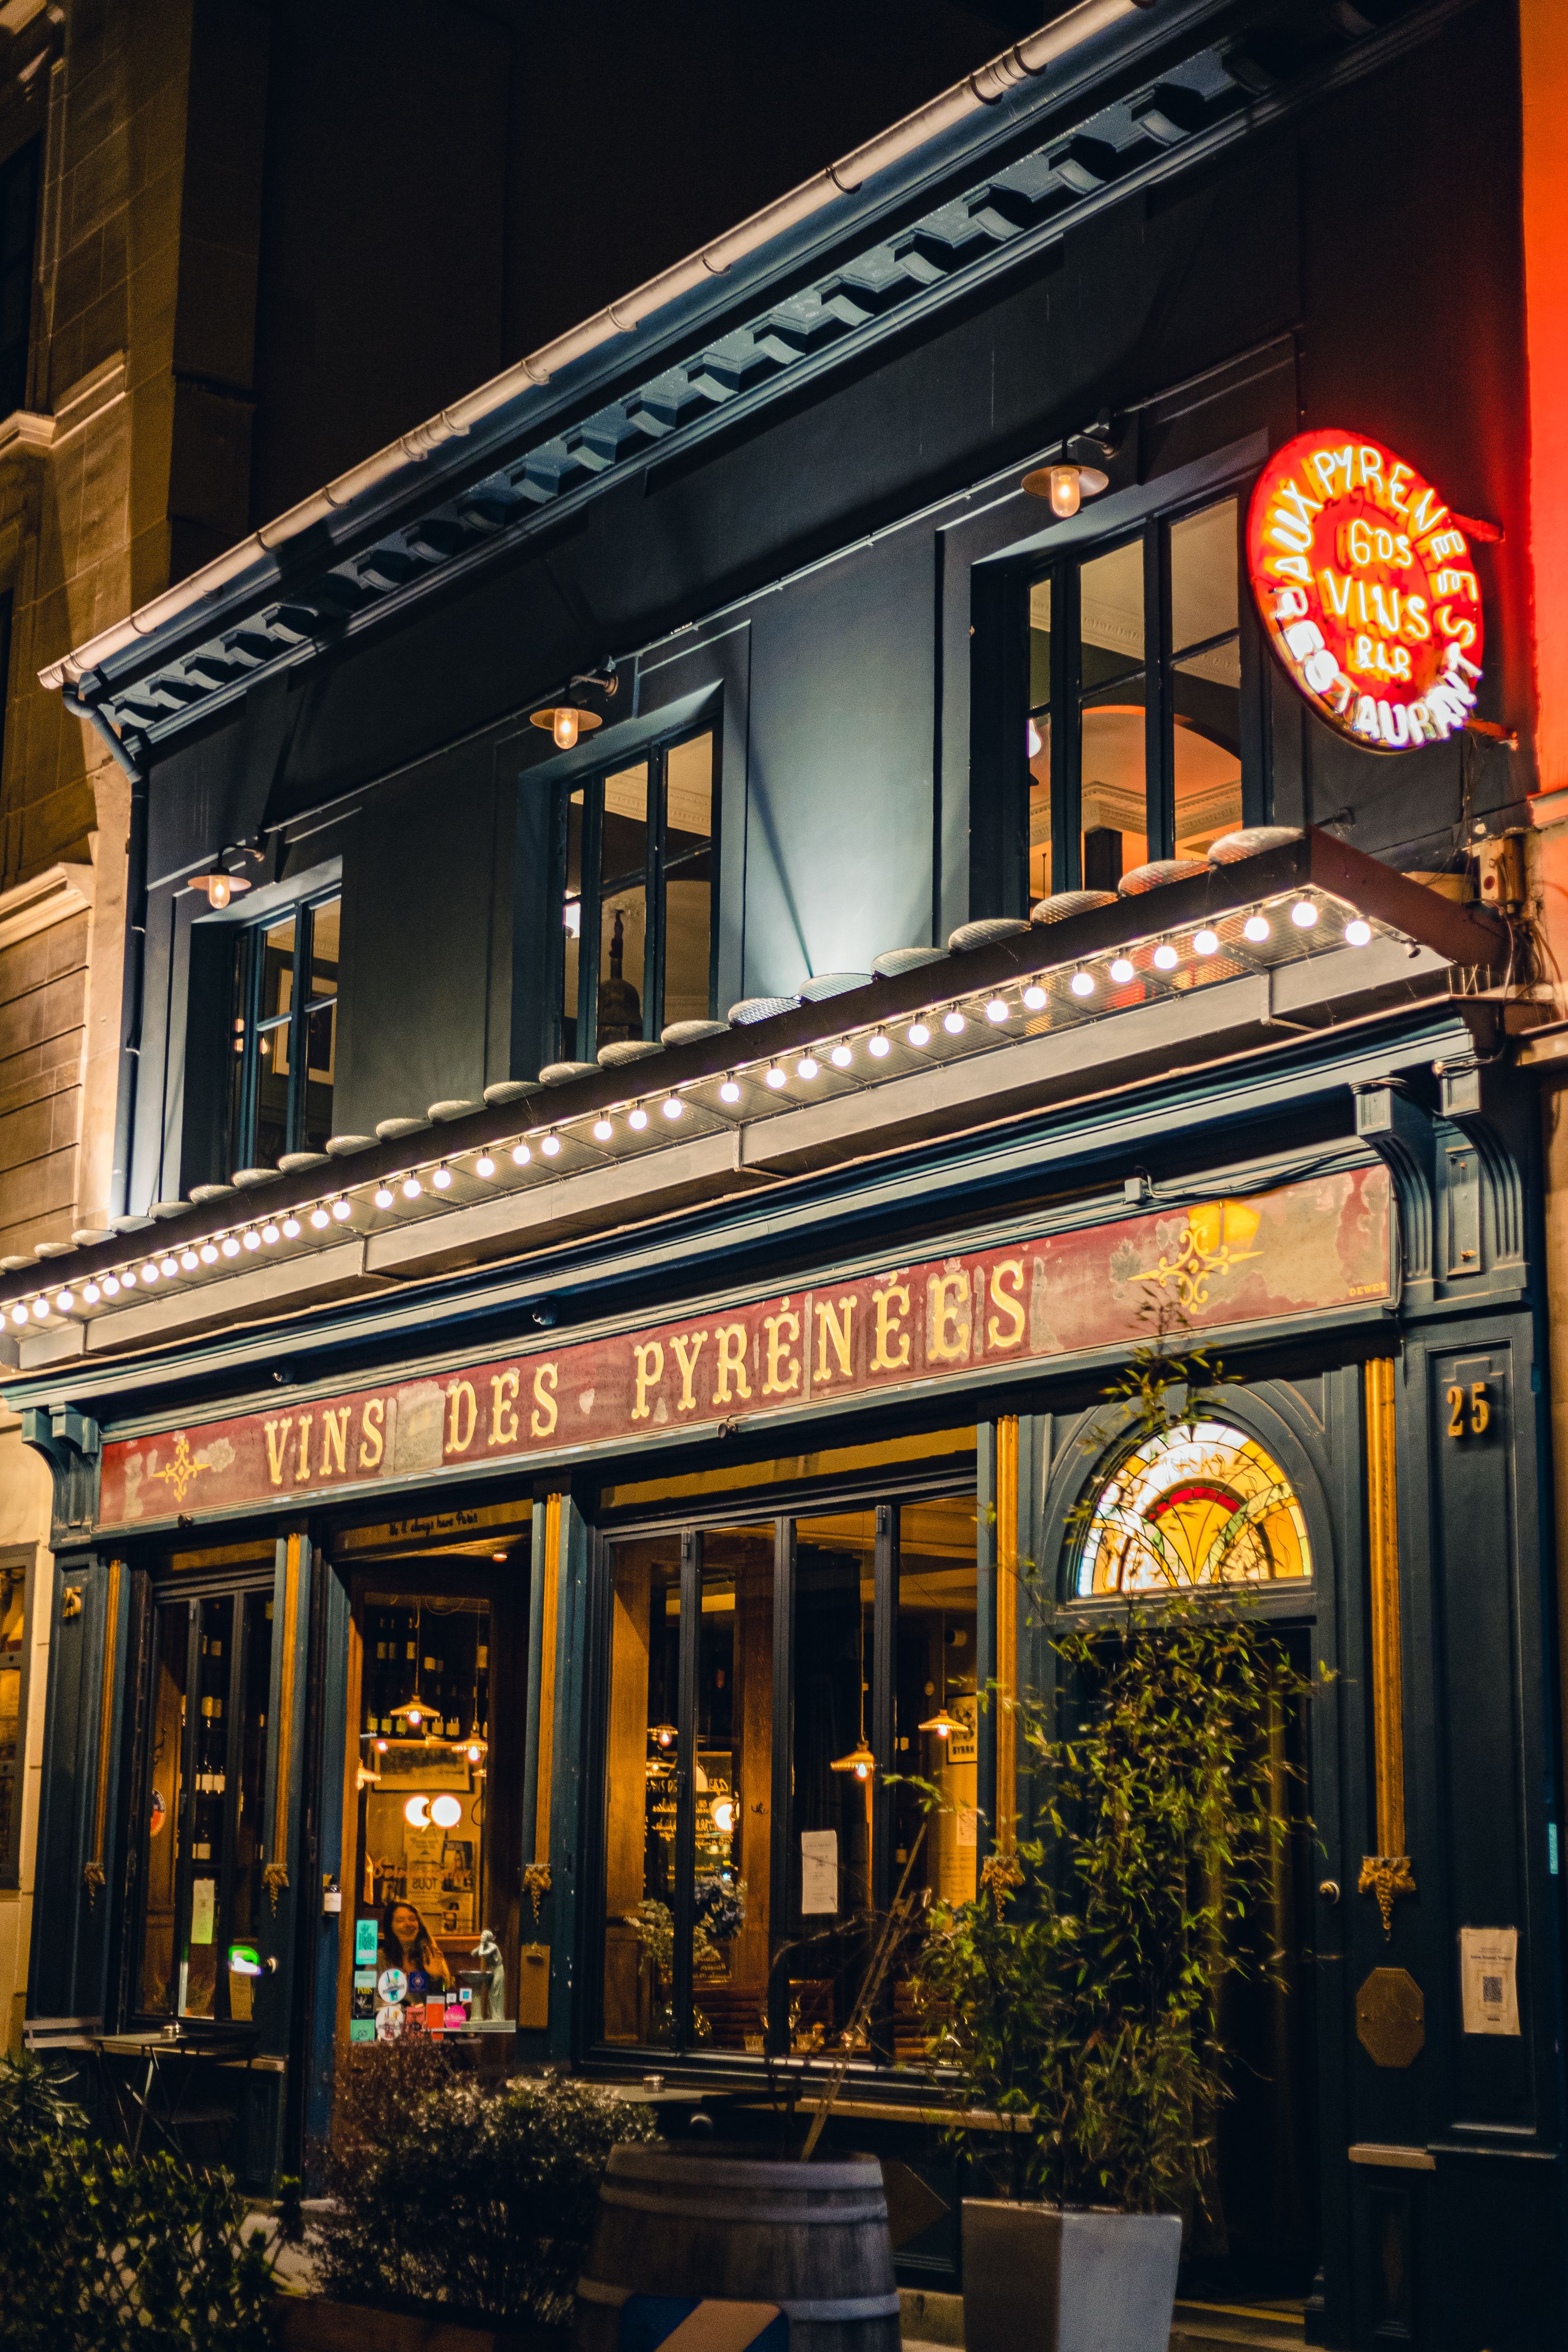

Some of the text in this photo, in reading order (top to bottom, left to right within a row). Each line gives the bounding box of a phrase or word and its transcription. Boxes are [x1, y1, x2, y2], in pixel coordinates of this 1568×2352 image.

[1270, 445, 1478, 647] AUX PYRENEES
[1323, 570, 1430, 639] VINS
[263, 1258, 1027, 1485] VINS DES PYRÉNÉES
[1446, 1381, 1489, 1437] 25
